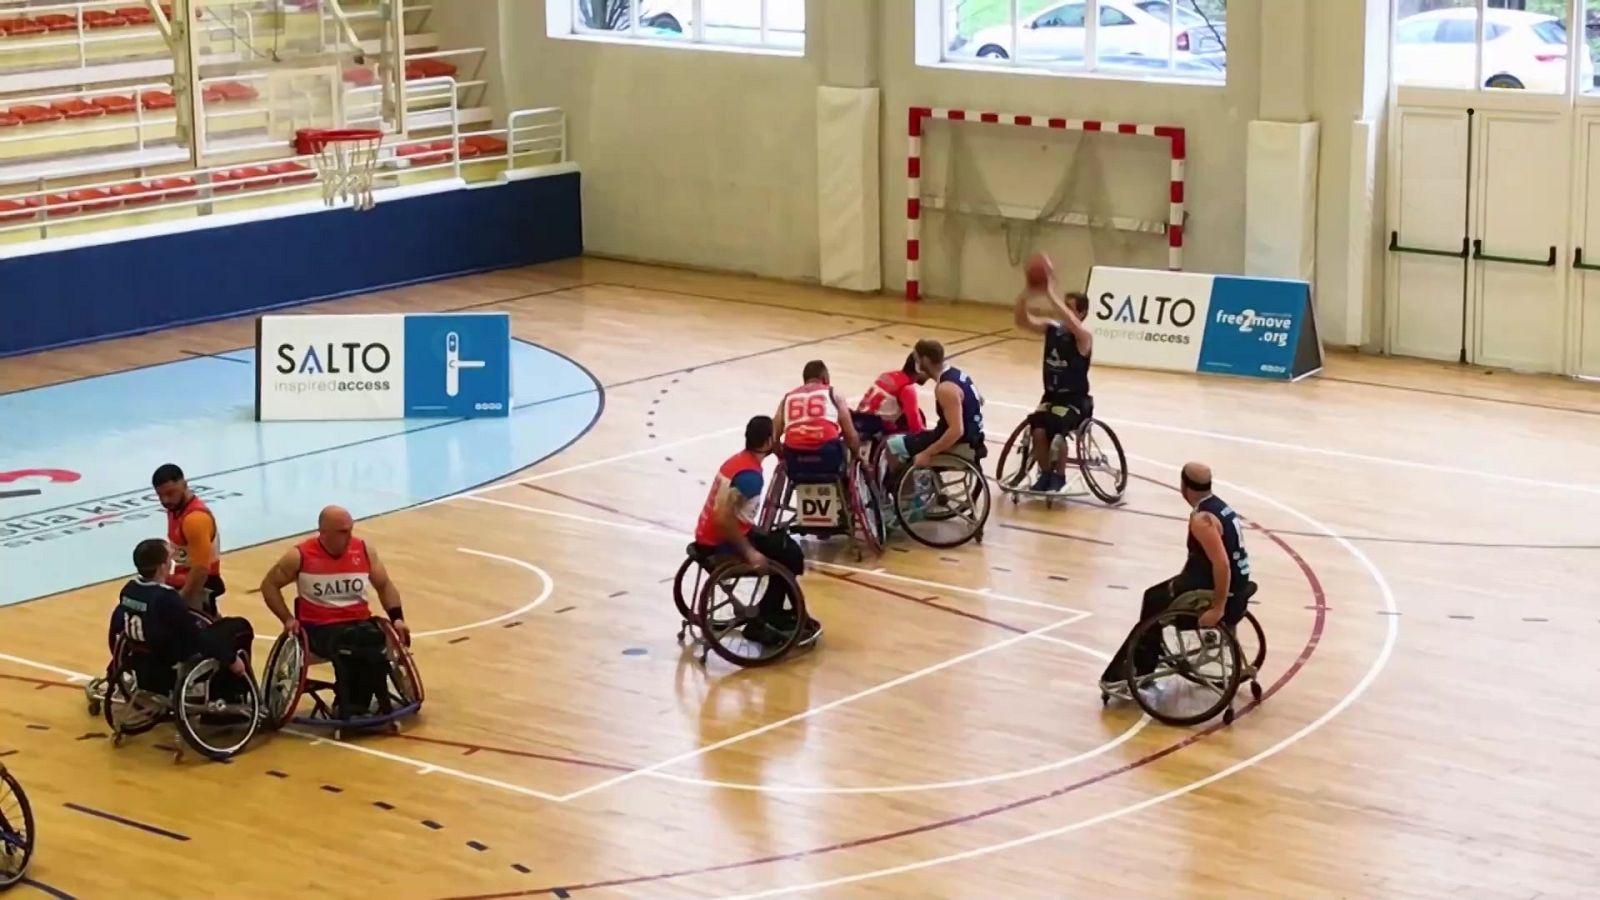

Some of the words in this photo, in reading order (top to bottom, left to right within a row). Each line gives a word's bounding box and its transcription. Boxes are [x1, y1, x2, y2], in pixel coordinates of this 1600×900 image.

[1096, 292, 1196, 328] SALTO
[1216, 309, 1292, 332] free2move
[1258, 331, 1289, 347] .org
[276, 342, 391, 375] SALTO
[789, 395, 826, 420] 66
[802, 499, 831, 517] DV
[313, 578, 364, 597] SALTO
